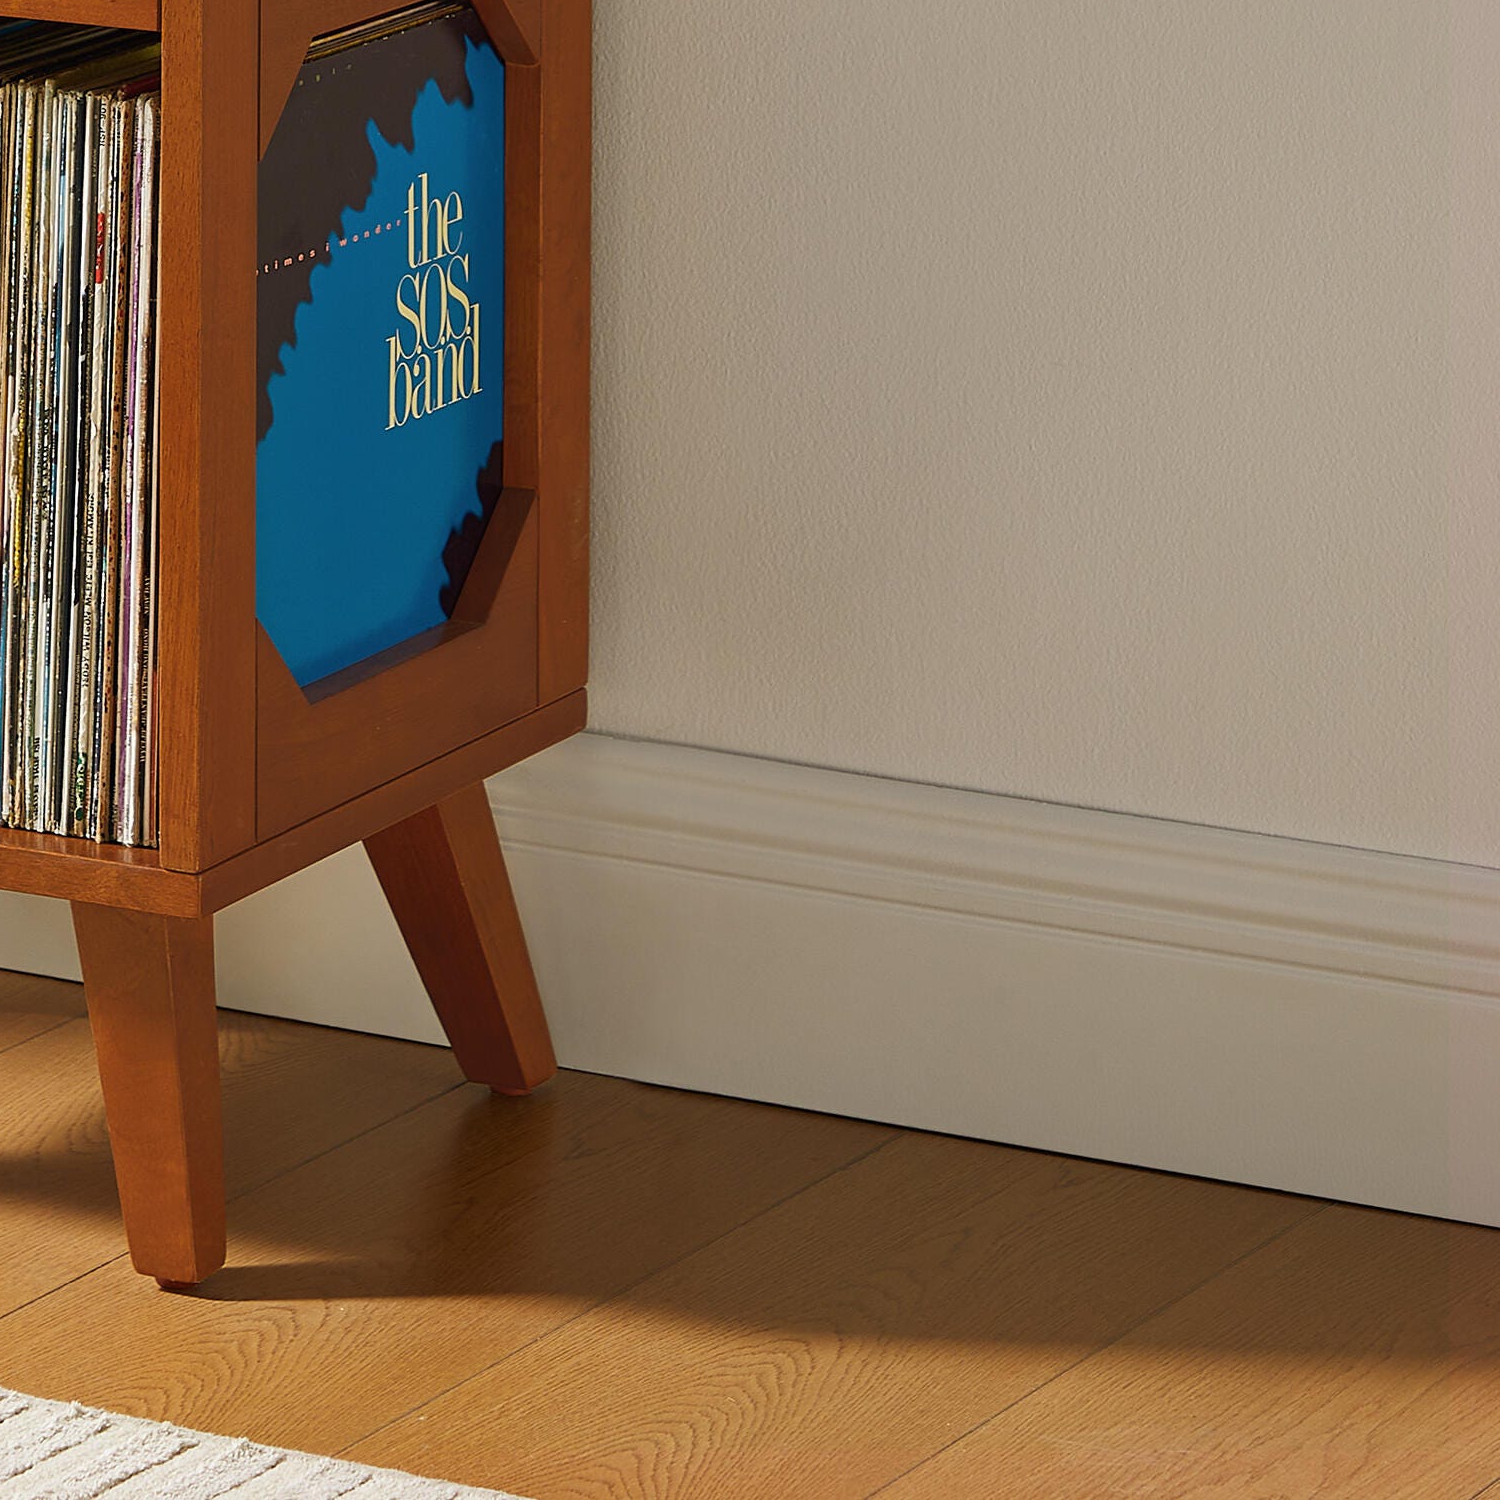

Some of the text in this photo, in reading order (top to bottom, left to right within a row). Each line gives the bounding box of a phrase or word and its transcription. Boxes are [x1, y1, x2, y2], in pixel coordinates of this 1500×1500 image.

[339, 219, 401, 247] wonder
[403, 172, 464, 269] the
[384, 302, 483, 431] band
